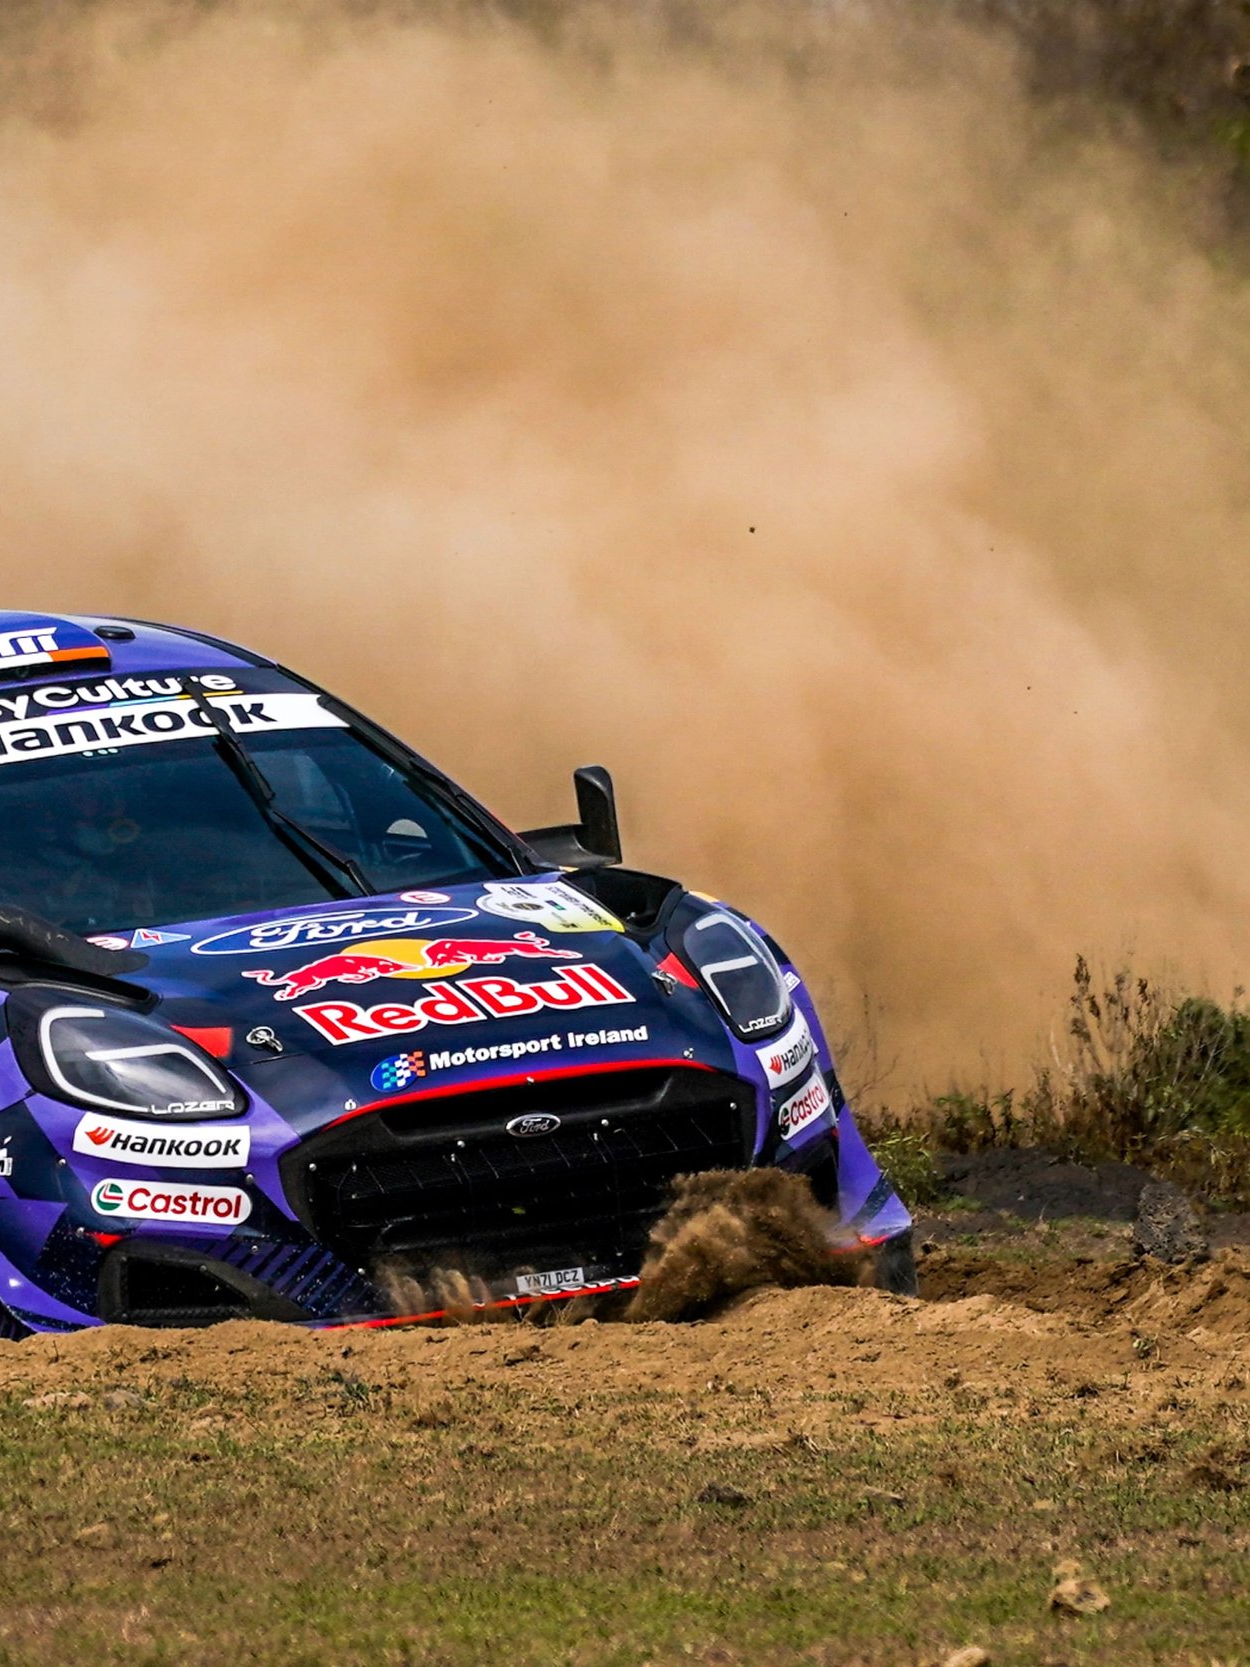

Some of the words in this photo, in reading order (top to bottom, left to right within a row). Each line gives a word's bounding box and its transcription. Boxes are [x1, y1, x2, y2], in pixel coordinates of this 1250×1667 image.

[250, 911, 432, 948] Ford
[292, 981, 487, 1046] Red
[454, 963, 636, 1018] Bull
[430, 1037, 561, 1071] Motorsport
[568, 1025, 648, 1048] Ireland
[520, 1117, 551, 1135] Ford
[127, 1188, 242, 1218] Castrol
[524, 1274, 552, 1288] YN71
[555, 1270, 579, 1284] DCZ
